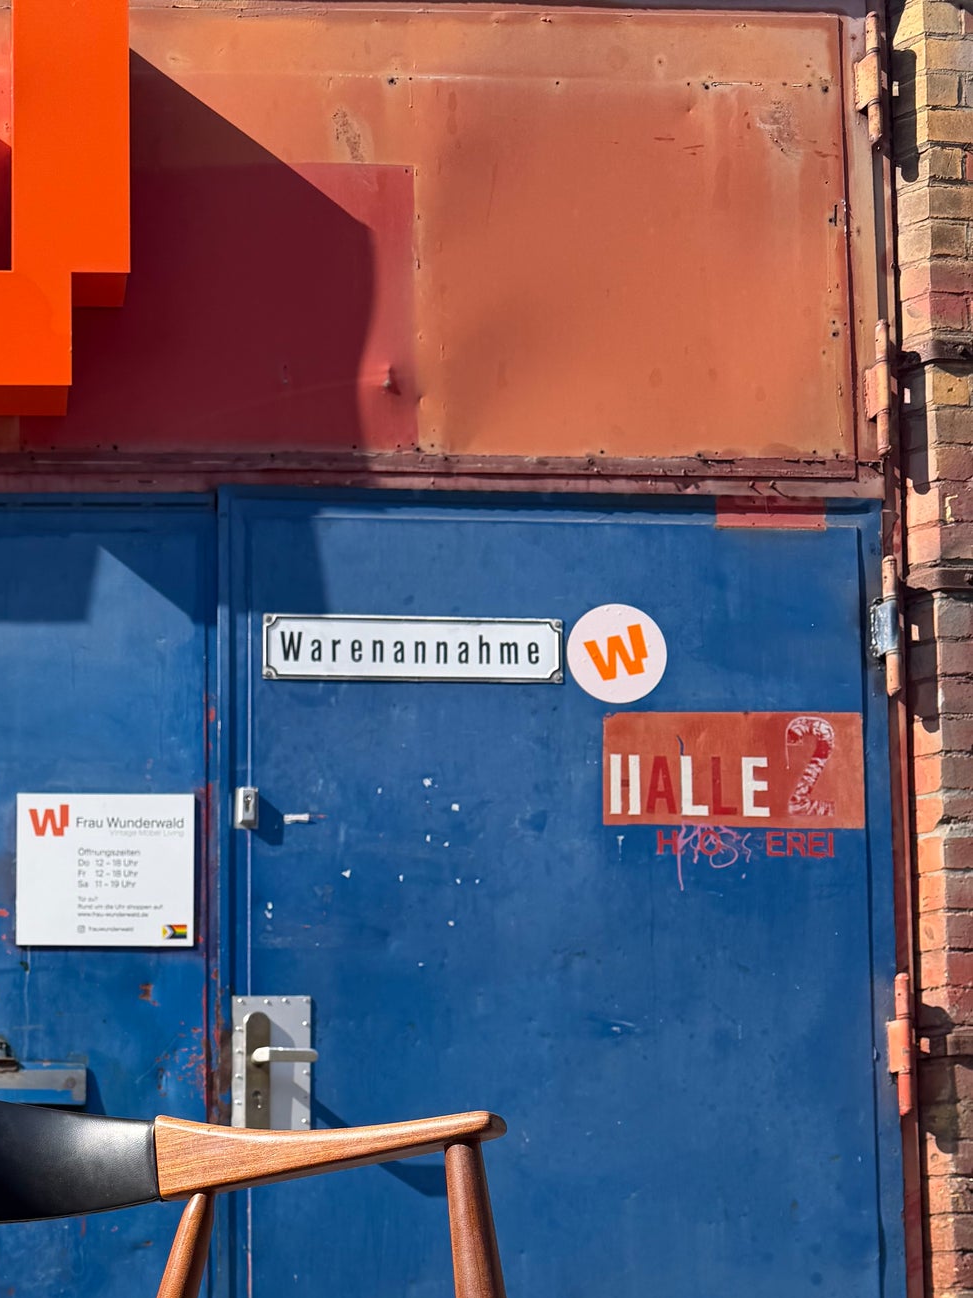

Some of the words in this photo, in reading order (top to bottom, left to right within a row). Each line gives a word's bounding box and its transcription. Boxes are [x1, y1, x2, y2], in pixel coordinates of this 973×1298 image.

[280, 630, 540, 665] Warenannahme
[583, 622, 649, 681] W
[609, 753, 771, 818] HALLE
[784, 715, 835, 817] 2
[29, 804, 69, 837] W
[75, 817, 104, 829] Frau
[107, 817, 184, 829] Wunderwald
[78, 858, 90, 867] Do
[95, 858, 104, 867] 12
[112, 859, 122, 867] 18
[123, 859, 138, 867] Uhr
[78, 869, 86, 878] Fr
[95, 869, 104, 878] 12
[112, 869, 122, 878] 18
[123, 869, 138, 878] Uhr
[78, 880, 89, 888] Sa
[95, 880, 102, 888] 11
[111, 880, 120, 888] 19
[121, 880, 136, 888] Uhr
